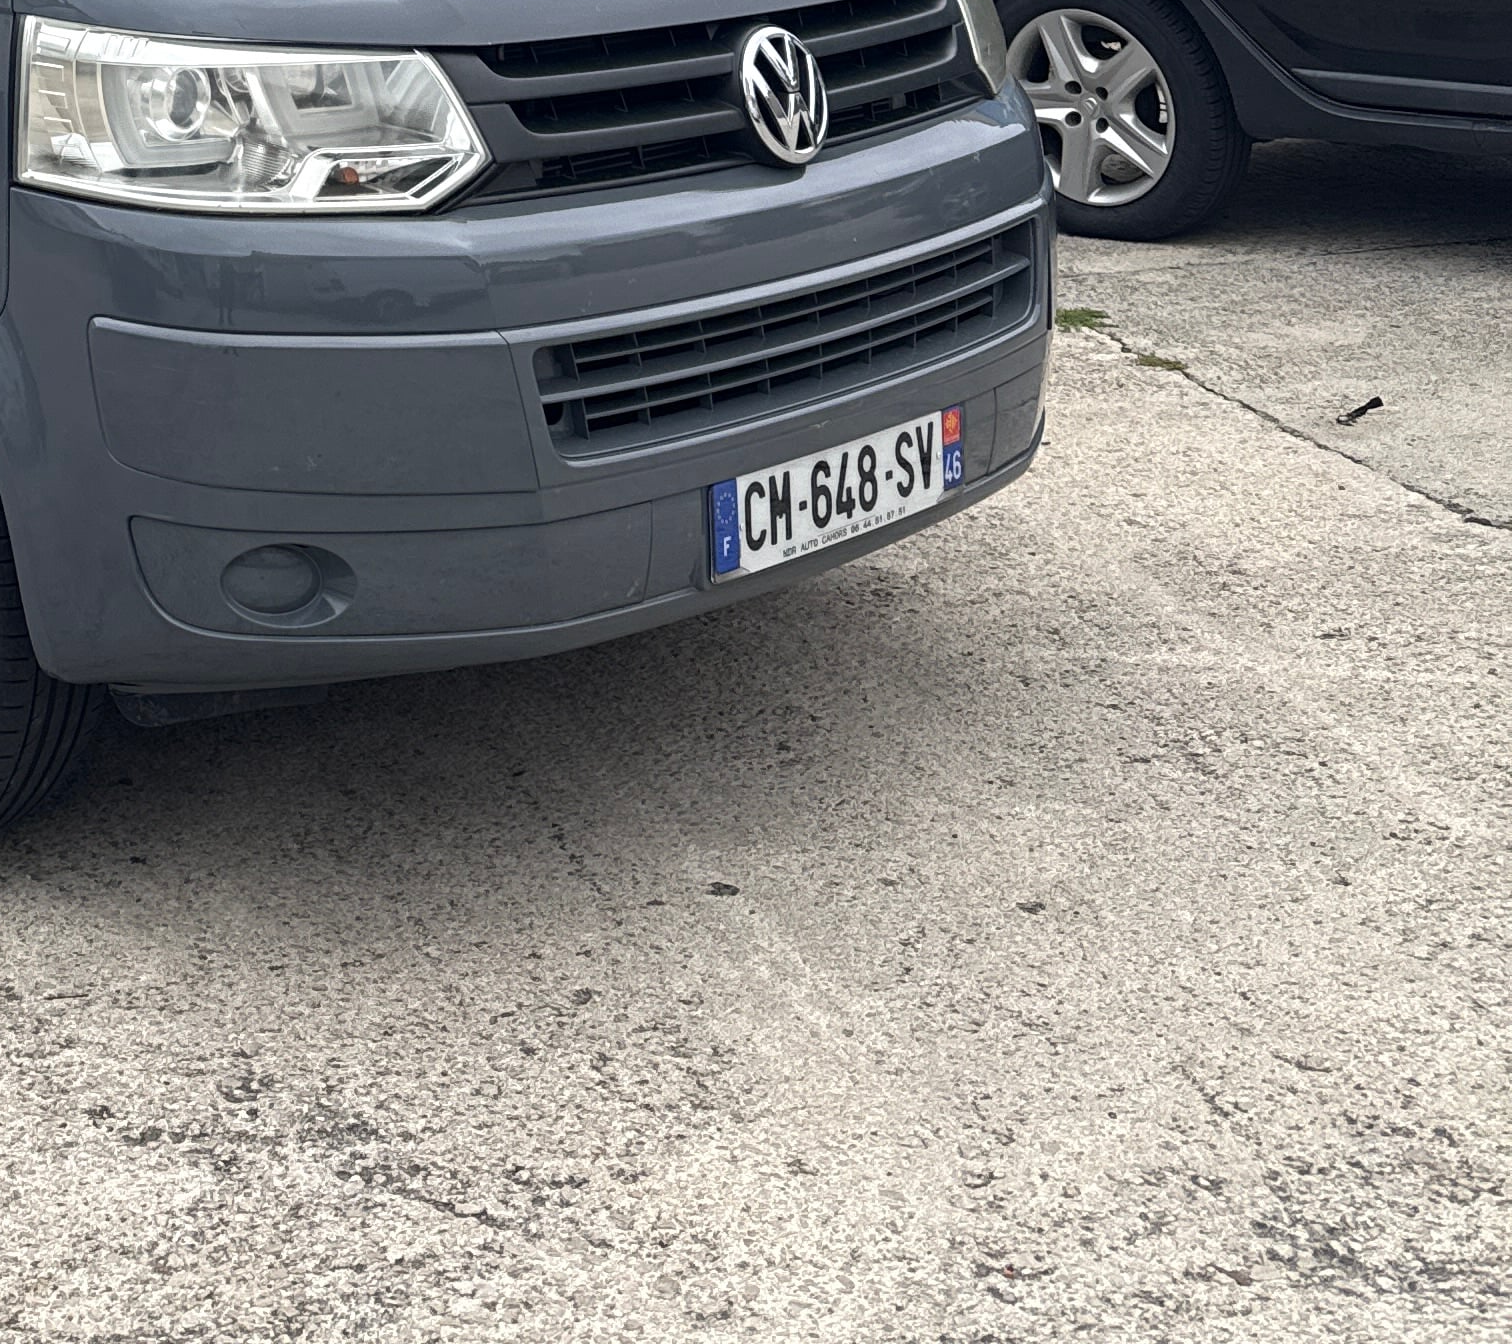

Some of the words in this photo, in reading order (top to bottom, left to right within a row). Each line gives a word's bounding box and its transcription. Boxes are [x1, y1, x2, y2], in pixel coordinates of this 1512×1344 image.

[723, 536, 731, 557] F
[744, 421, 934, 552] CM-648-SV
[944, 450, 962, 482] 46
[800, 537, 819, 552] AUTO
[821, 527, 848, 545] CAHORS
